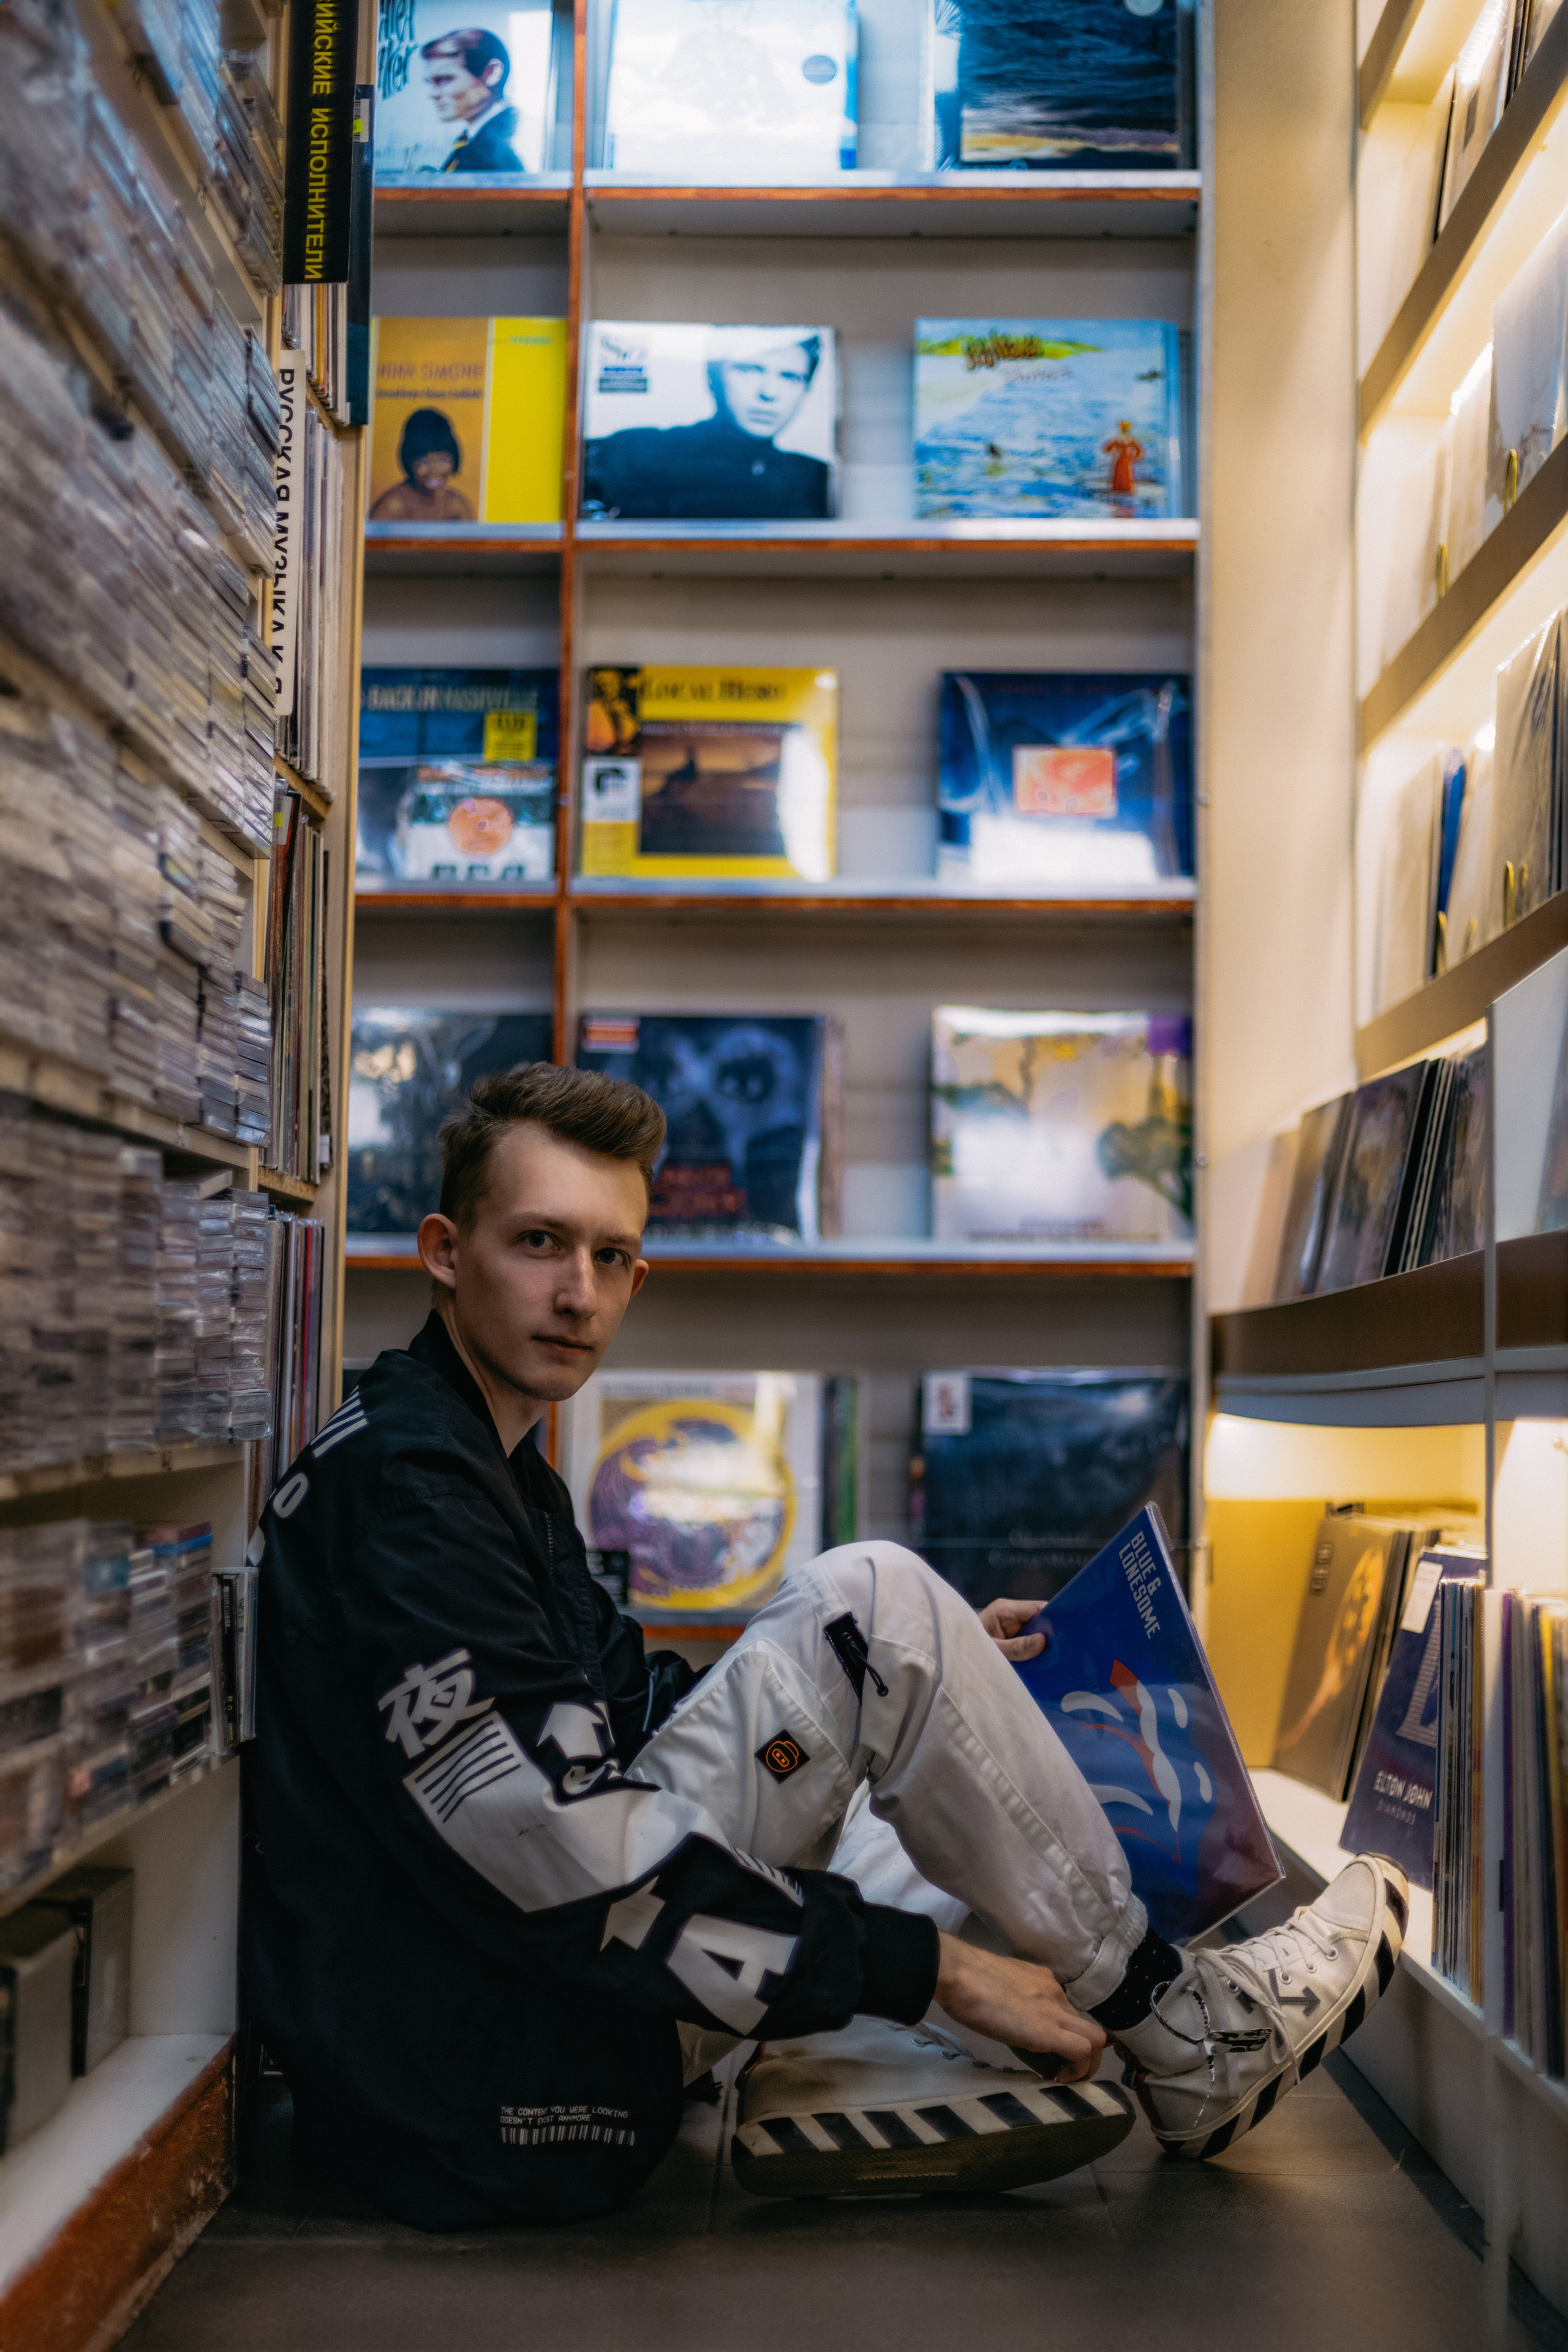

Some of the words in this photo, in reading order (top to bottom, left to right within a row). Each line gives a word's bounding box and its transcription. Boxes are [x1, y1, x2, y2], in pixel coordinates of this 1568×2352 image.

[312, 0, 339, 95] ИЙСКИЕ
[304, 108, 330, 279] ИСПОЛНИТЕЛИ
[1119, 1542, 1161, 1640] LONESOME
[1131, 1531, 1156, 1580] BLUE
[1147, 1577, 1161, 1596] &
[378, 1648, 496, 1759] 夜
[1373, 1770, 1406, 1799] ELTON
[1403, 1782, 1433, 1810] JOHN
[501, 2106, 514, 2115] THE
[518, 2107, 548, 2117] CONTENT
[592, 2106, 628, 2119] LOOKING
[537, 2115, 554, 2125] EXIST
